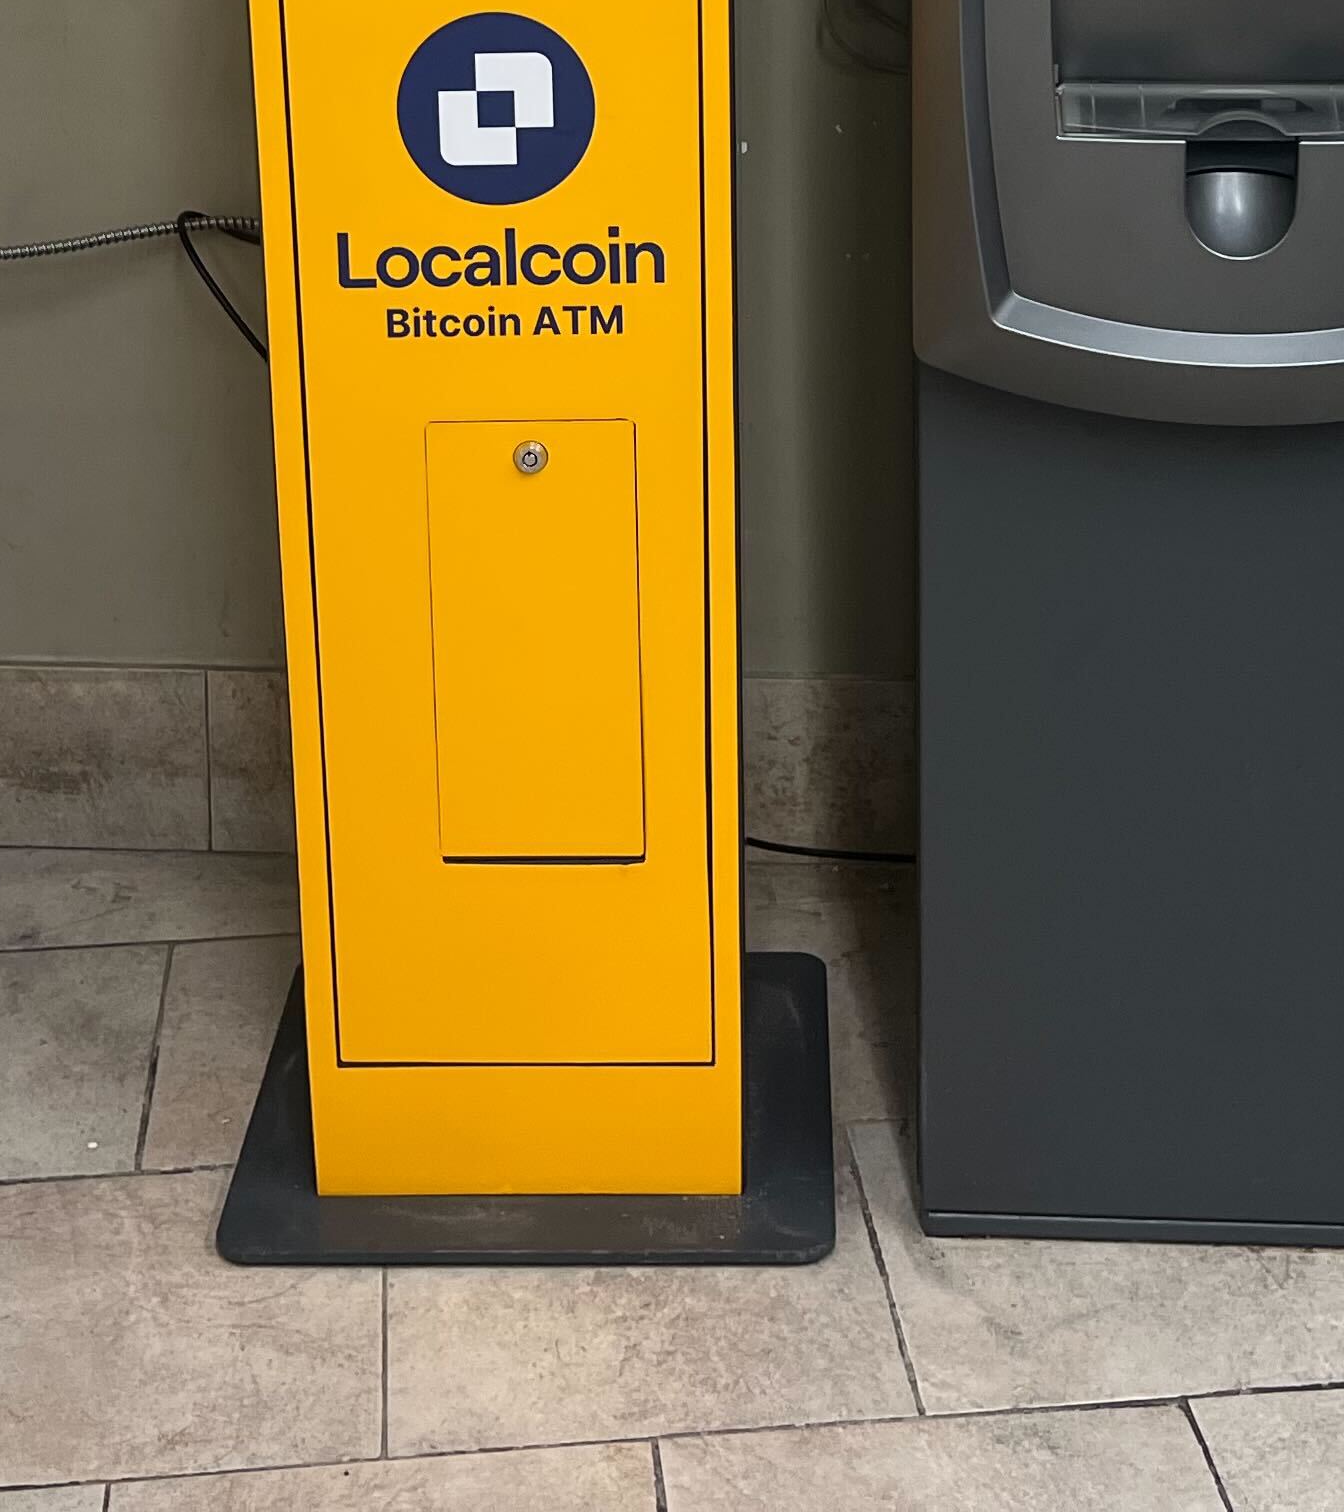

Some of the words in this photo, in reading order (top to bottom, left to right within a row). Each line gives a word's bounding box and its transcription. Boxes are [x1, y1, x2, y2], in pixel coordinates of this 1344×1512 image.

[336, 225, 666, 290] Localcoin
[386, 306, 522, 338] Bitcoin
[533, 305, 624, 336] ATM
